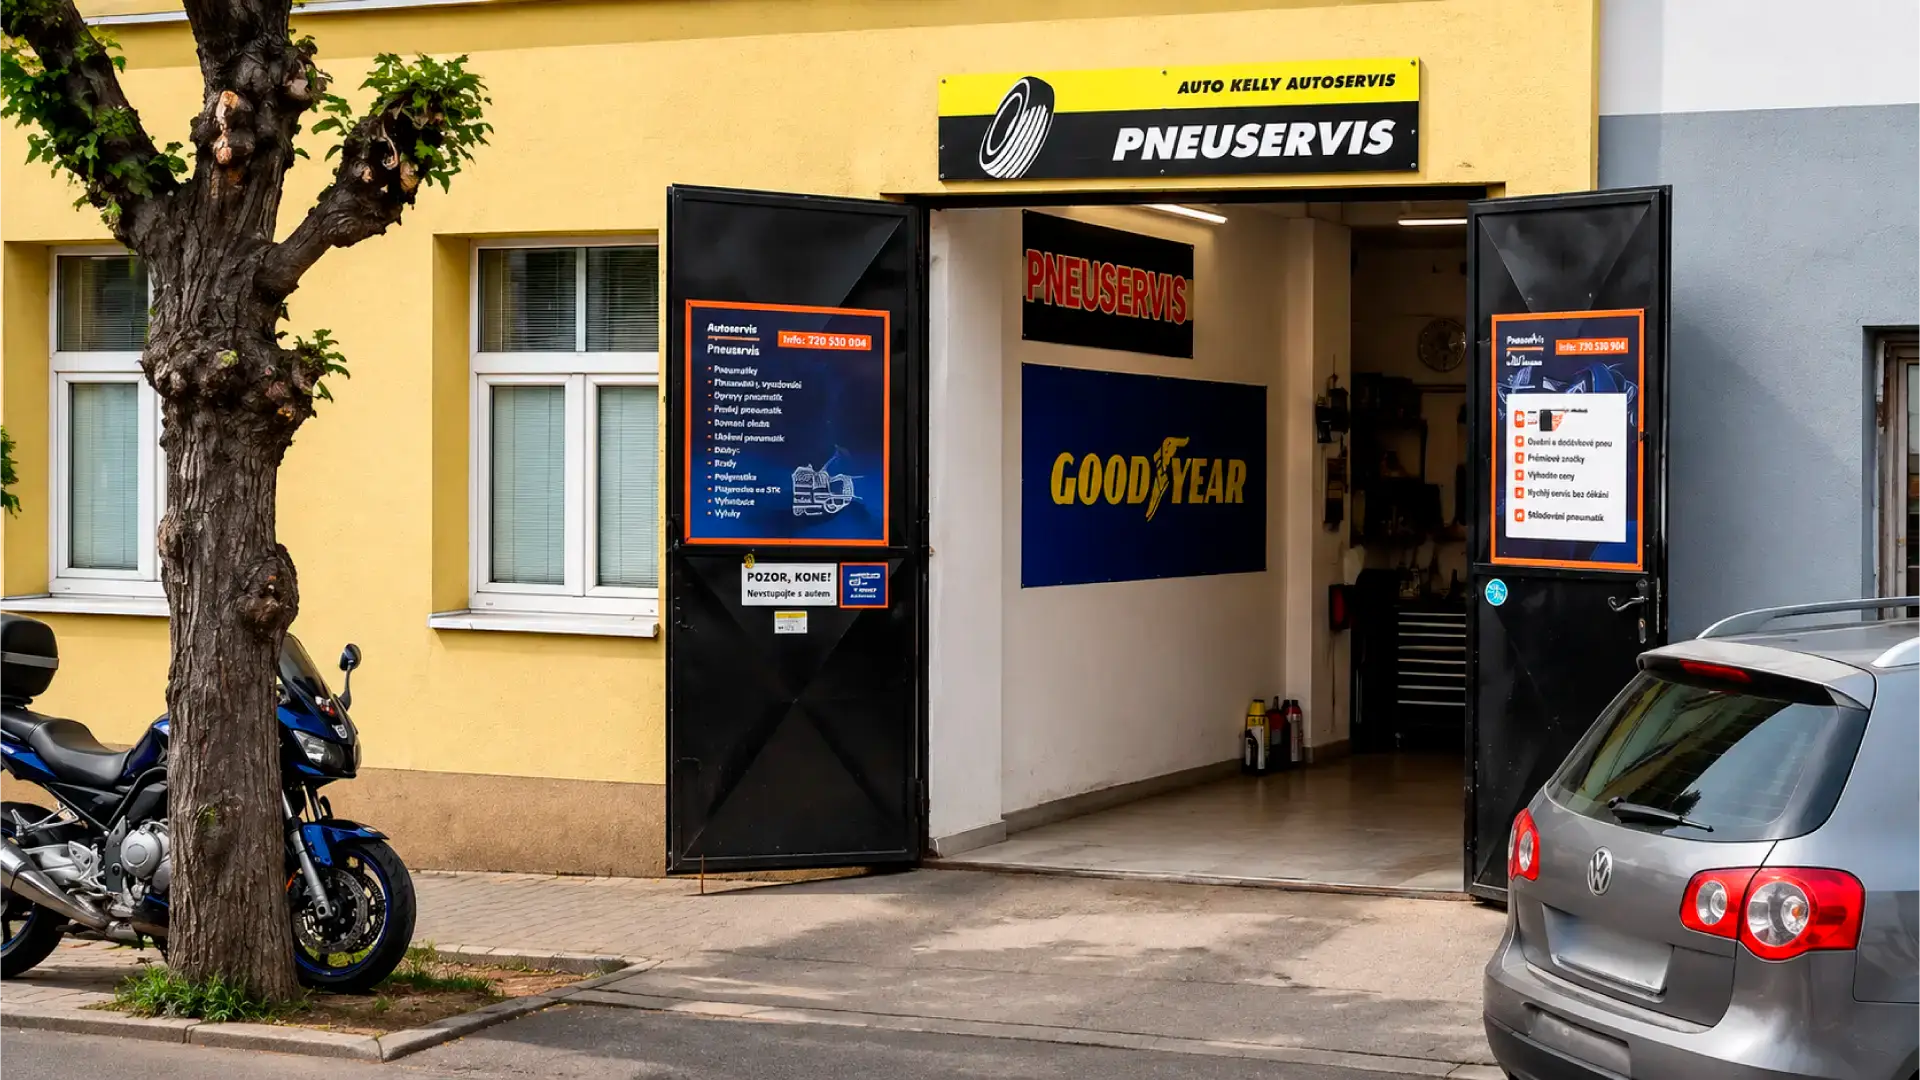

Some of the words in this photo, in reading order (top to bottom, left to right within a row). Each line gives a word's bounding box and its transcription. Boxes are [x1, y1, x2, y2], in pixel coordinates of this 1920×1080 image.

[1178, 79, 1223, 94] AUTO
[1229, 76, 1281, 92] KELLY
[1285, 73, 1396, 91] AUTOSERVIS
[1112, 118, 1397, 162] PNEUSERVIS
[1025, 248, 1188, 325] PNEUSERVIS
[707, 323, 757, 334] Autoservis
[747, 572, 791, 583] POZOR,
[795, 572, 831, 582] KONE!
